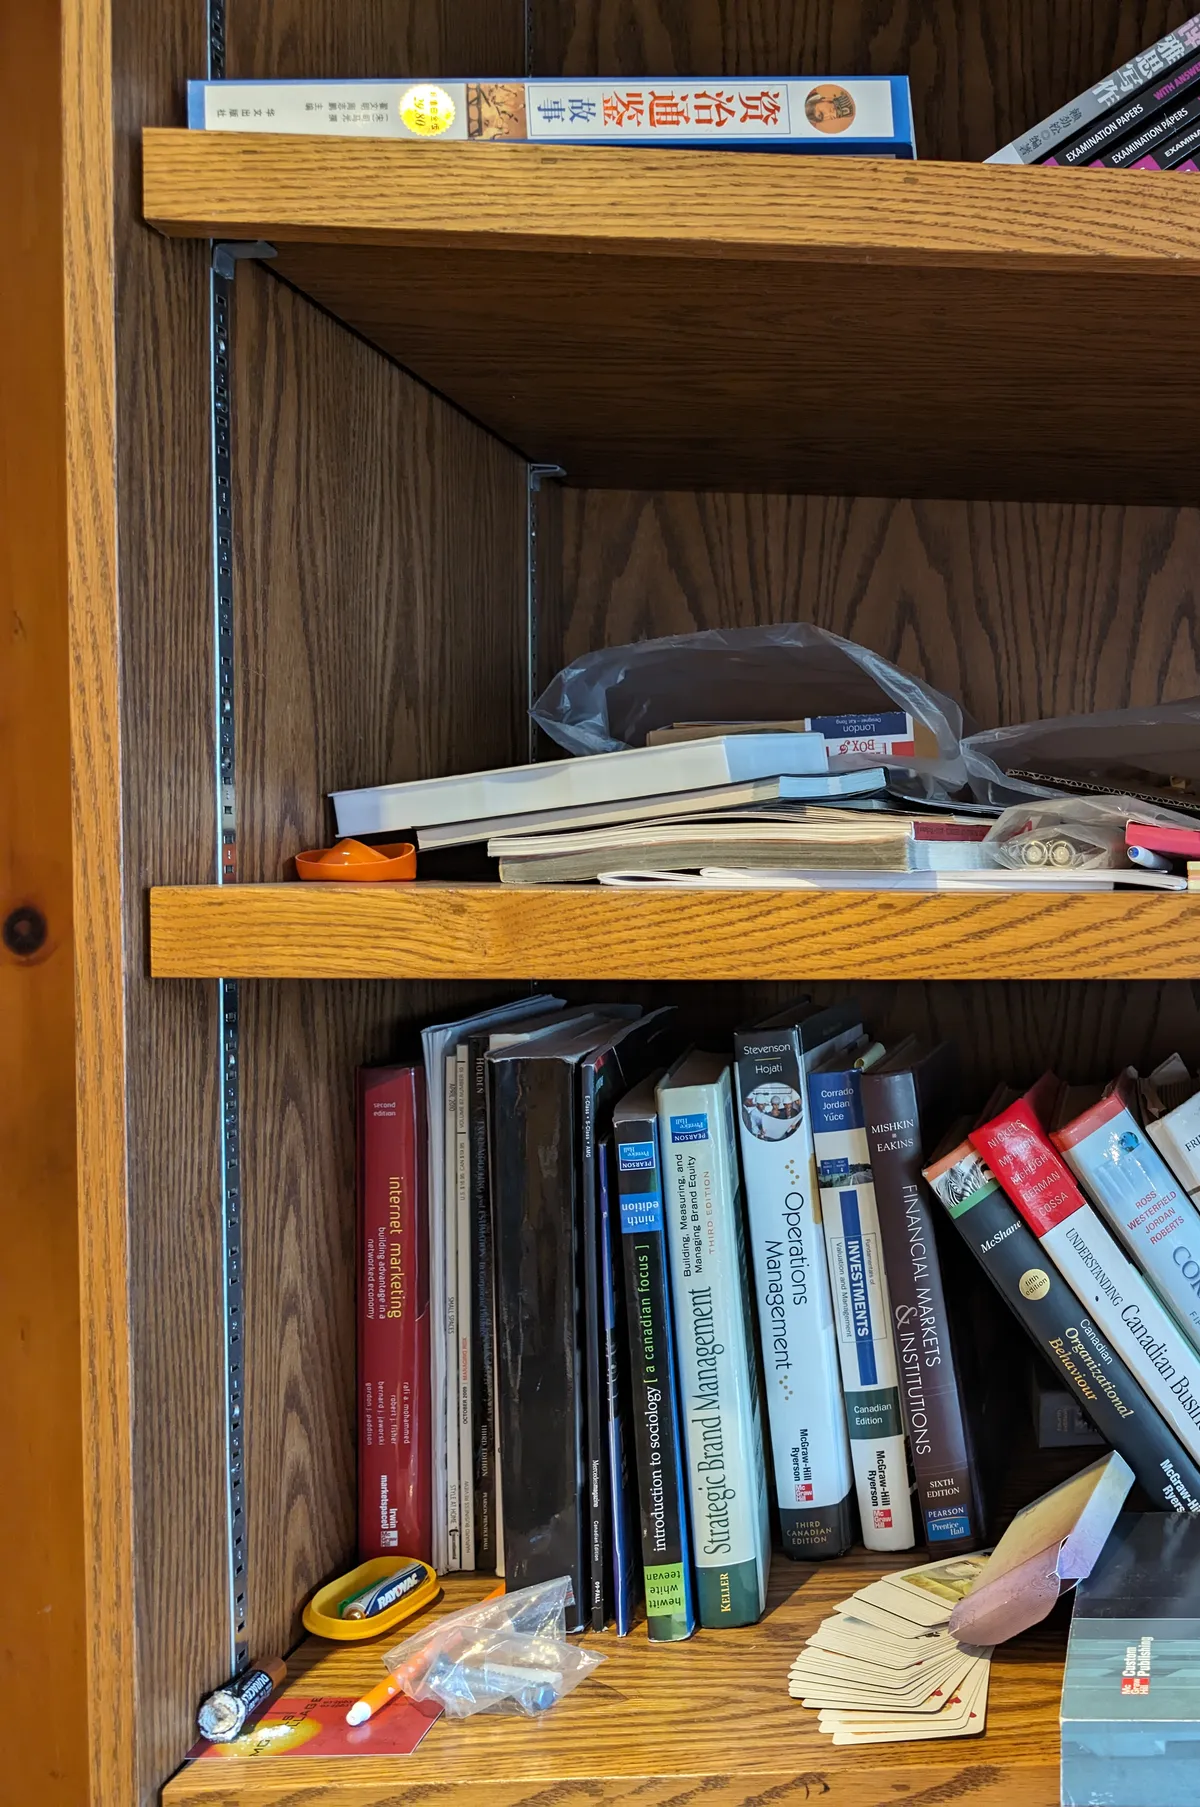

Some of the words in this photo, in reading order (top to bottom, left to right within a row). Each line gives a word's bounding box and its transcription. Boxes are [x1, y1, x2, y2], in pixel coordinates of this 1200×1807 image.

[1091, 32, 1185, 105] 雅思写作
[1151, 81, 1175, 101] WITH
[216, 108, 276, 118] 华文出版社
[536, 98, 596, 123] 故事
[602, 90, 780, 127] 资治通鉴
[1064, 120, 1119, 162] EXAMINATION
[1114, 103, 1144, 128] PAPERS
[1110, 123, 1164, 165] EXAMINATION
[1159, 106, 1189, 131] PAPERS
[843, 724, 875, 733] London
[743, 1042, 791, 1055] Stevenson
[755, 1063, 783, 1076] Hojati
[820, 1087, 854, 1098] Corrado
[822, 1100, 851, 1110] Jordan
[674, 1131, 707, 1141] PEARSON
[871, 1118, 914, 1134] MISHKIN
[877, 1138, 914, 1152] EAKINS
[622, 1161, 652, 1169] PEARSON
[674, 1154, 684, 1172] and
[685, 1154, 699, 1187] Equity
[388, 1176, 403, 1234] internet
[621, 1200, 660, 1213] edition
[688, 1189, 700, 1221] Brand
[1124, 1190, 1180, 1231] WESTERFIELD
[1133, 1189, 1159, 1210] ROSS
[628, 1213, 655, 1227] ninth
[705, 1220, 716, 1254] THIRD
[902, 1184, 929, 1281] FINANCIAL
[978, 1217, 1024, 1254] McShane
[1141, 1206, 1178, 1234] JORDAN
[1147, 1214, 1187, 1245] ROBERTS
[365, 1238, 375, 1281] networked
[376, 1227, 386, 1259] building
[690, 1224, 705, 1273] Managing
[781, 1191, 811, 1306] Operations
[835, 1241, 845, 1275] Valuation
[376, 1261, 385, 1302] advantage
[385, 1243, 404, 1318] marketing
[635, 1254, 650, 1292] focus
[846, 1239, 869, 1336] INVESTMENTS
[365, 1282, 375, 1319] economy
[759, 1238, 794, 1370] Management
[1063, 1225, 1123, 1308] UNDERSTANDING
[1116, 1302, 1182, 1381] Canadian
[638, 1295, 655, 1360] canadian
[915, 1286, 941, 1368] MARKETS
[1076, 1316, 1117, 1365] Canadian
[683, 1285, 728, 1411] Management
[1046, 1333, 1102, 1403] Behaviour
[1060, 1324, 1136, 1421] Organizational
[853, 1402, 892, 1414] Canadian
[898, 1330, 931, 1455] INSTITUTIONS
[642, 1384, 665, 1450] sociology
[855, 1416, 883, 1426] Edition
[691, 1406, 725, 1471] Brand
[798, 1428, 811, 1481] McGraw-Hill
[648, 1451, 661, 1465] to
[790, 1446, 801, 1481] Ryerson
[865, 1469, 880, 1507] Ryerson
[874, 1450, 890, 1506] McGraw-Hill
[926, 1486, 960, 1498] EDITION
[929, 1477, 954, 1488] SIXTH
[388, 1508, 397, 1528] Irwin
[648, 1469, 667, 1551] introduction
[697, 1473, 737, 1554] Strategic
[795, 1520, 821, 1529] THIRD
[928, 1506, 964, 1518] PEARSON
[931, 1521, 959, 1531] Prentice
[786, 1527, 832, 1537] CANADIAN
[792, 1536, 827, 1545] EDITION
[950, 1527, 964, 1536] Hall
[377, 1573, 419, 1610] RAYOVAC
[646, 1570, 681, 1581] teevan
[650, 1584, 679, 1596] white
[720, 1572, 732, 1613] KELLER
[649, 1597, 681, 1609] hewitt
[1122, 1645, 1139, 1677] Custom
[1134, 1634, 1155, 1677] Publishing
